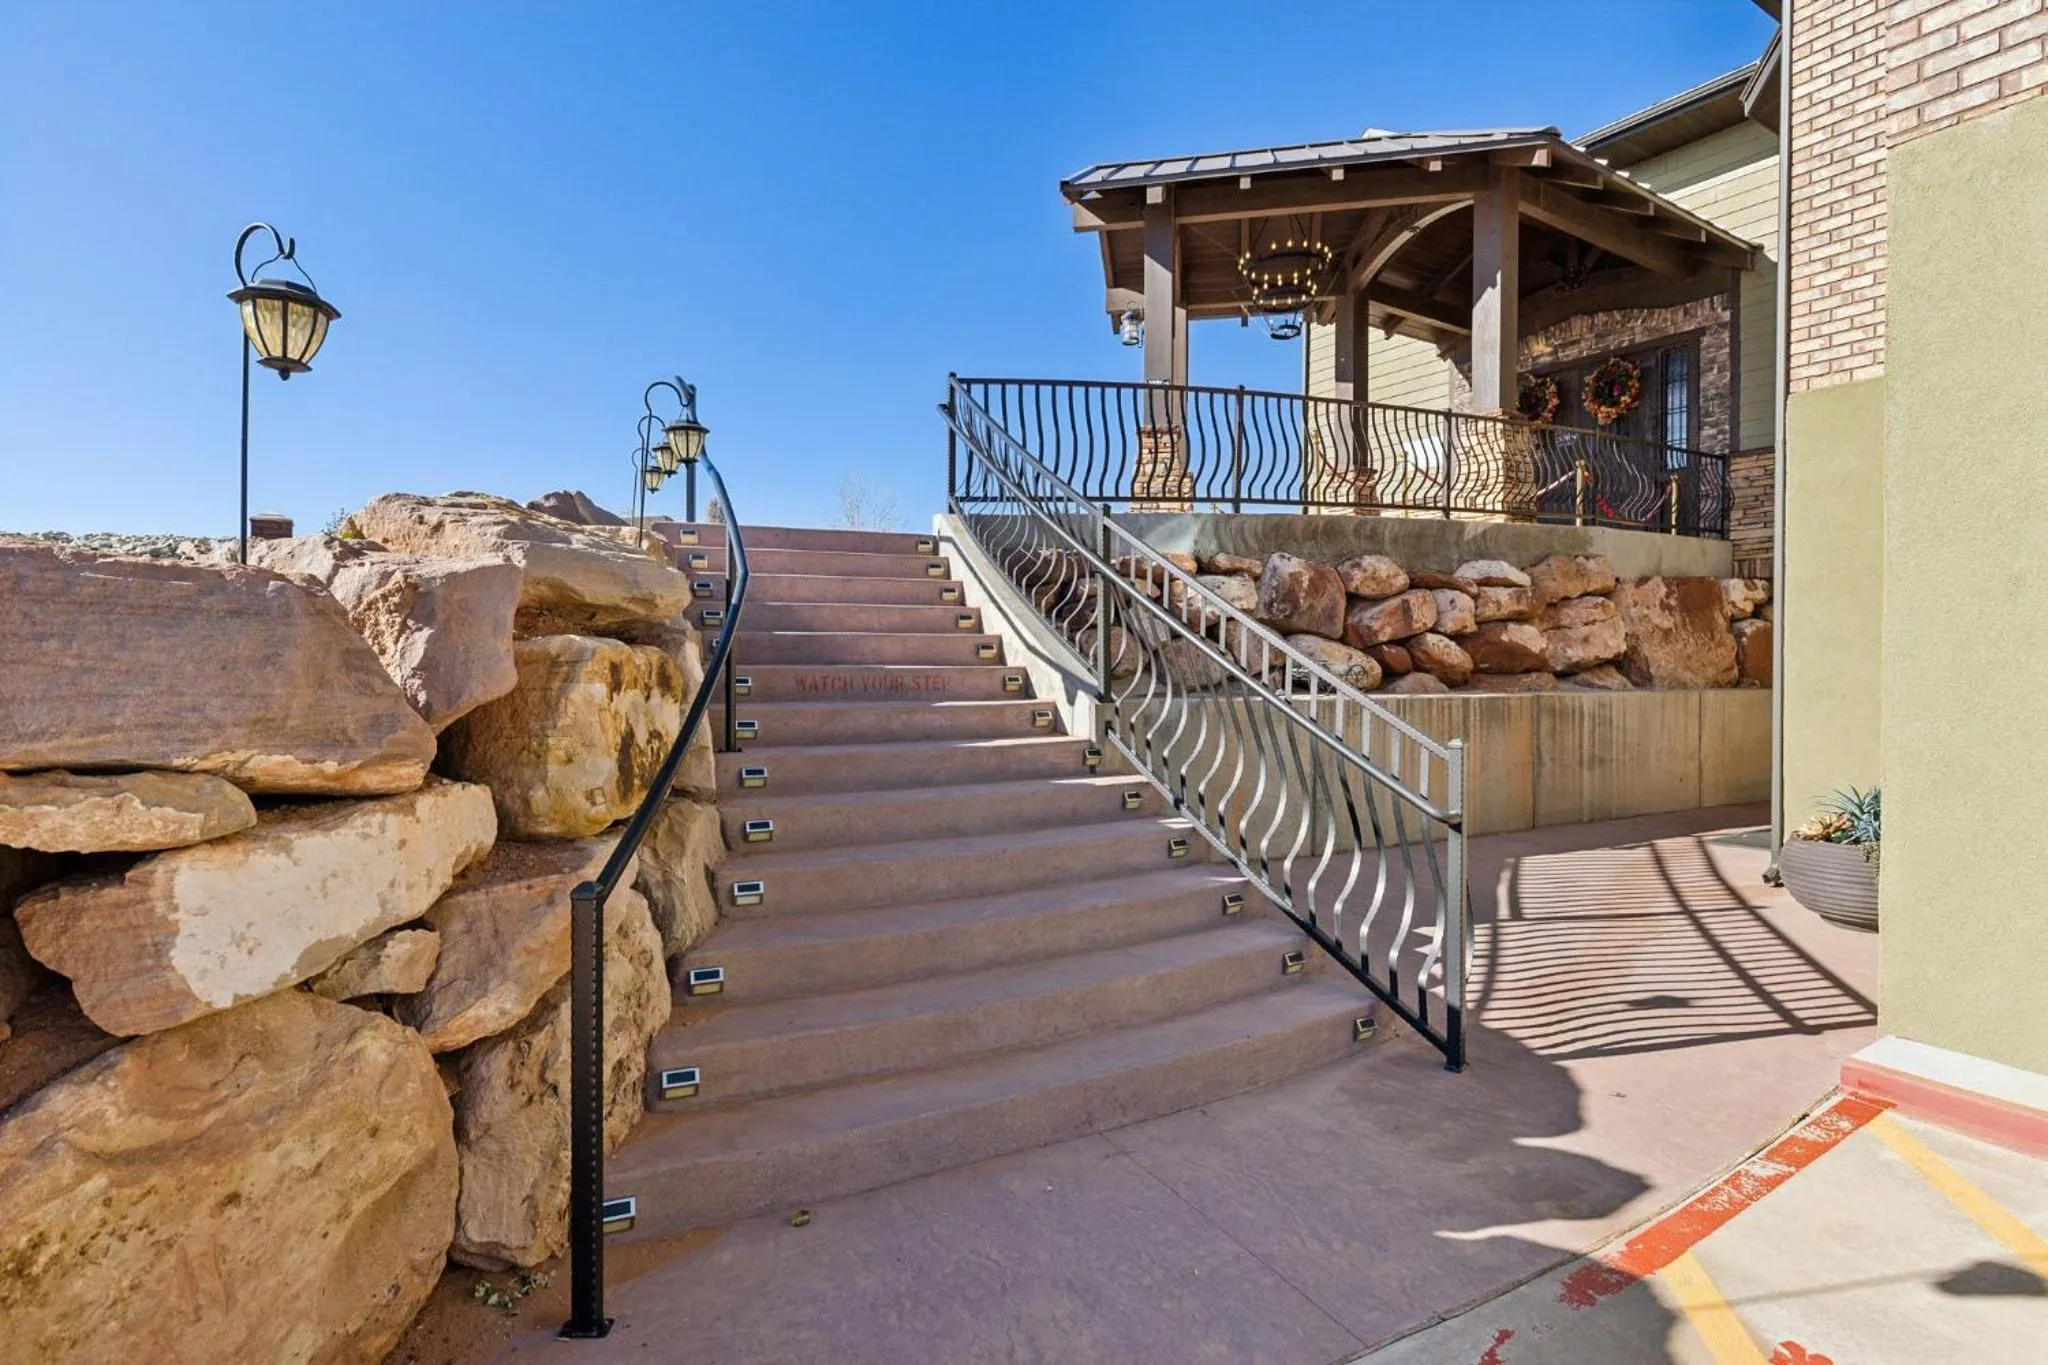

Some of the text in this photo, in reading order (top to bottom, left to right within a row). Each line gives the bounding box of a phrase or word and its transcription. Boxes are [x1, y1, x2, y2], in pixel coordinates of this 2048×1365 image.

[794, 674, 952, 693] WATCH YOUR STEP
